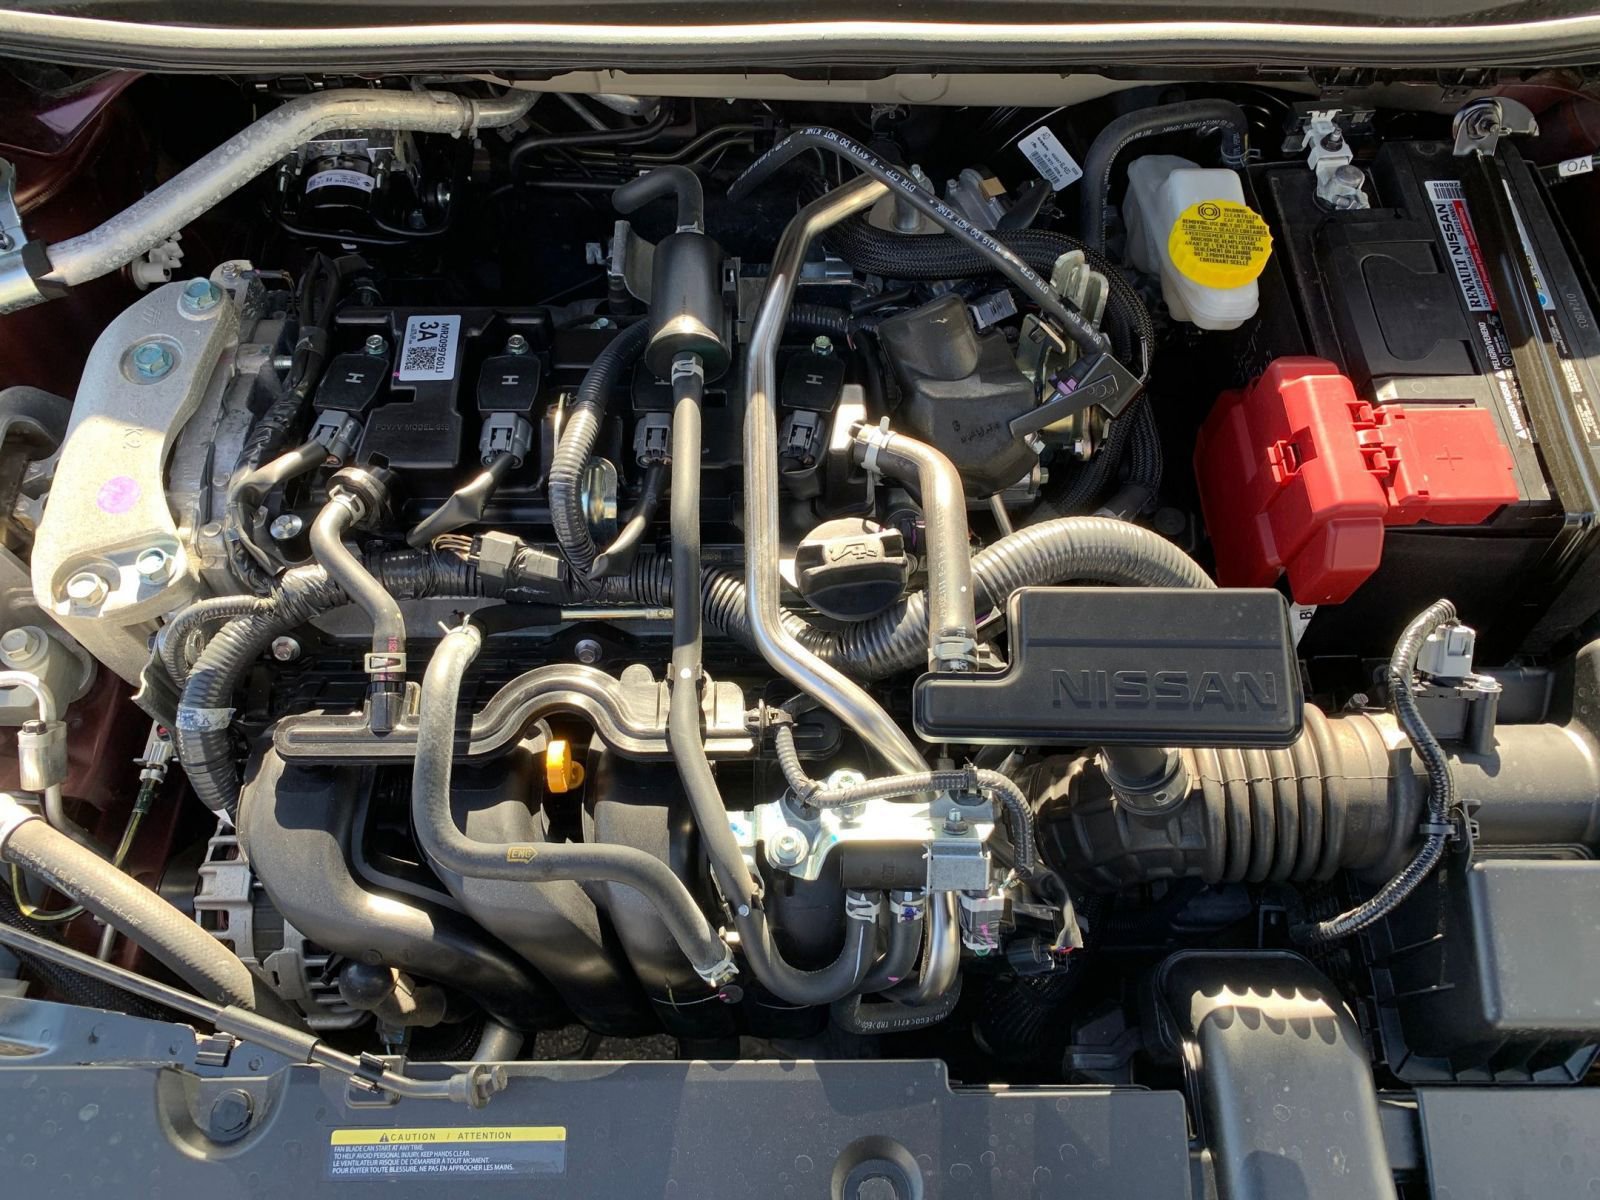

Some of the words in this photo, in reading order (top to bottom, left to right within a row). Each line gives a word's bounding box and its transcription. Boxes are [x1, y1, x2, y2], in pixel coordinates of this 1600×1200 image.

[824, 132, 838, 142] NOT
[840, 138, 850, 148] DO
[954, 216, 970, 232] NOT
[1435, 203, 1462, 254] NISSAN
[970, 228, 982, 239] DO
[1454, 258, 1482, 308] RENAULT
[417, 321, 439, 342] 3A
[1051, 670, 1277, 711] NISSAN
[391, 1133, 436, 1141] CAUTION
